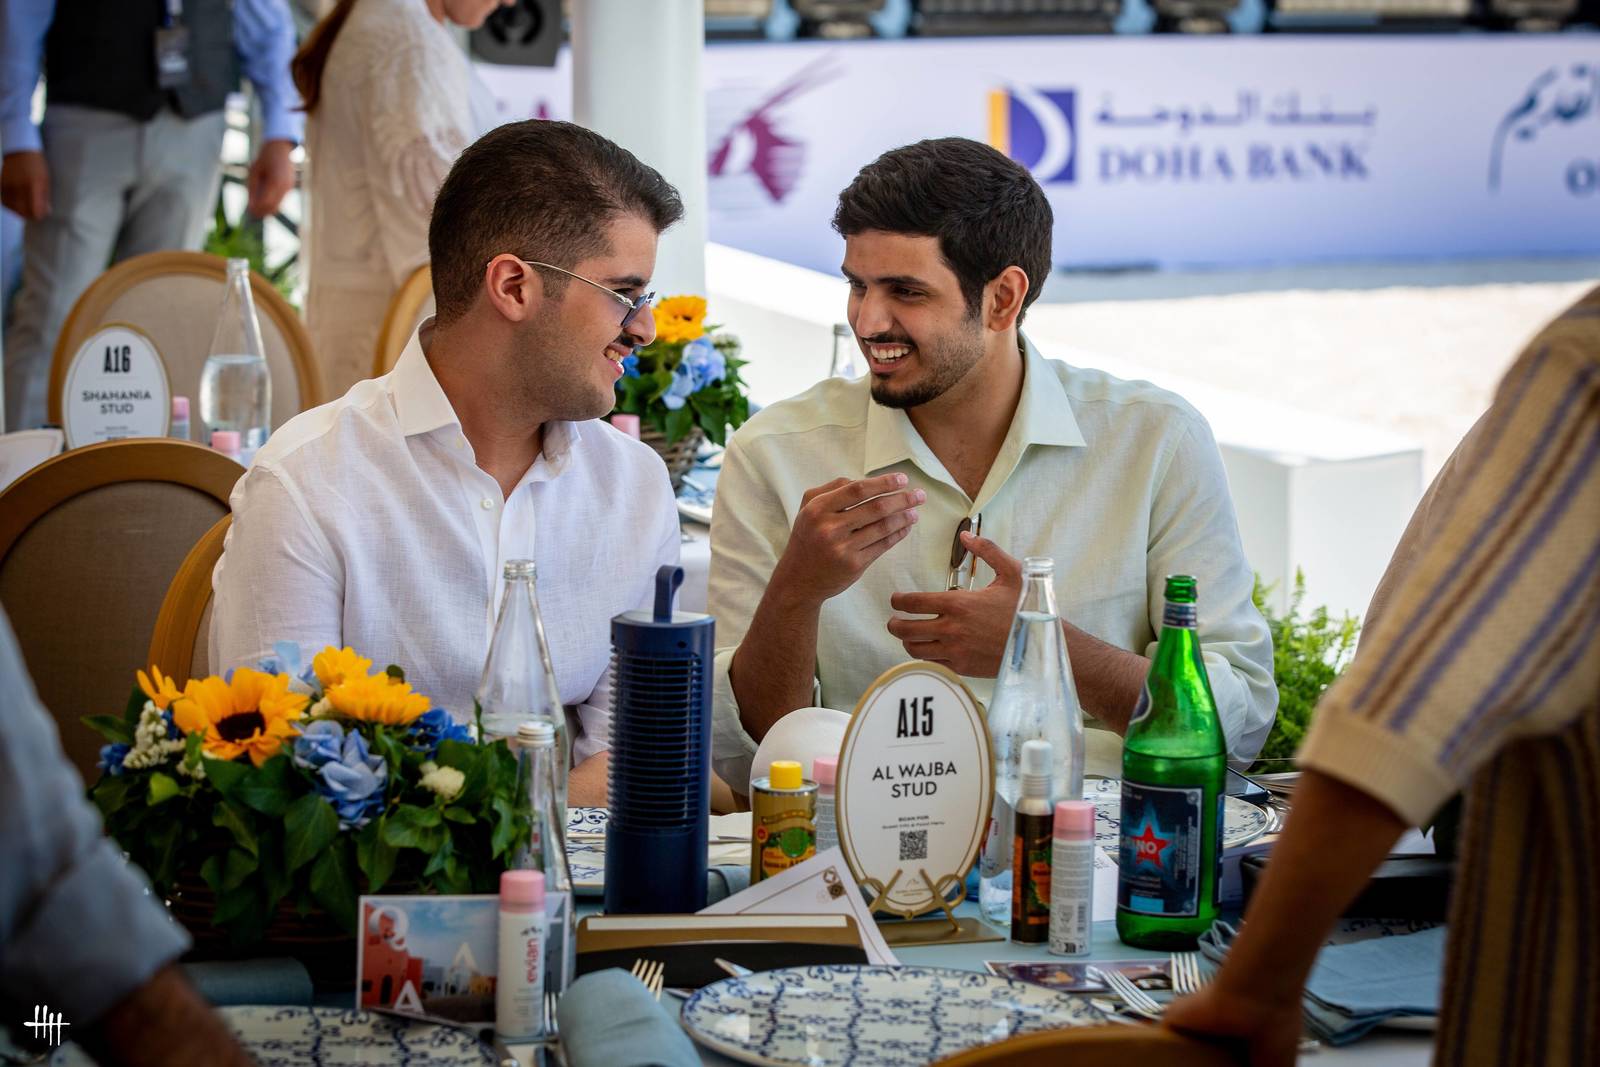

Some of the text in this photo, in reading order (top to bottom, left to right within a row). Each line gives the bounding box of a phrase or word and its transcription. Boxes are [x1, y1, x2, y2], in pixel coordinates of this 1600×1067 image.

[1098, 144, 1369, 179] DOHA BANK
[104, 346, 131, 373] A16
[82, 390, 152, 401] SHAHANIA
[101, 403, 134, 414] STUD
[896, 696, 934, 738] A15
[872, 761, 957, 780] AL WAJBA
[891, 781, 938, 798] STUD
